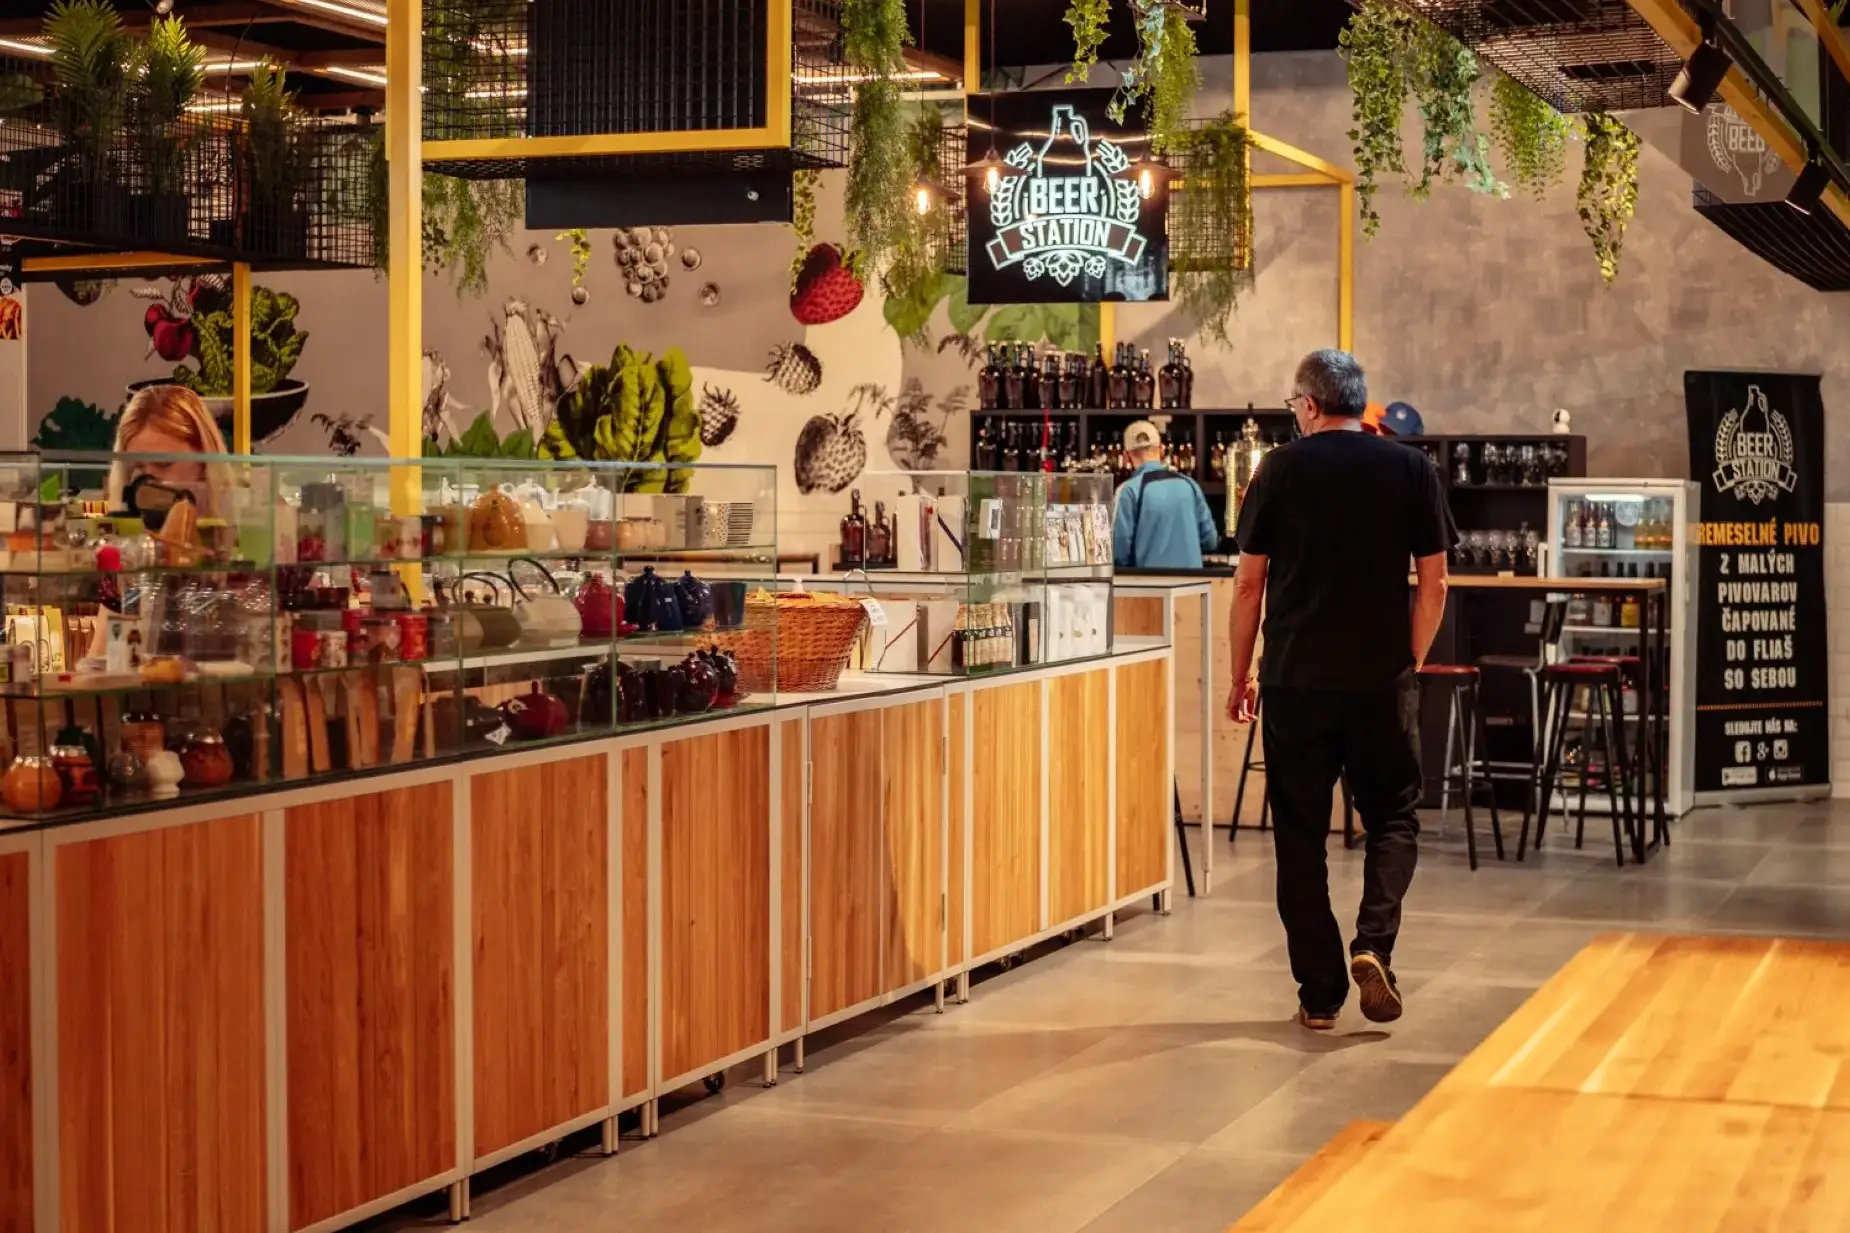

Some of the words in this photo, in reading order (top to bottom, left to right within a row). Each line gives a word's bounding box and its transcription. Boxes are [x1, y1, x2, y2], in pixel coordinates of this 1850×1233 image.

[1030, 177, 1099, 214] BEER
[1019, 219, 1110, 249] STATION
[1737, 432, 1774, 457] BEER
[1732, 458, 1780, 480] STATION
[1696, 516, 1777, 545] REMESELNÉ
[1784, 522, 1820, 545] PIVO
[1719, 552, 1730, 574] Z
[1738, 548, 1795, 574] MALÝCH
[1718, 581, 1797, 603] PIVOVAROV
[1722, 605, 1796, 632] ČAPOVANÉ
[1726, 639, 1746, 661] DO
[1753, 634, 1793, 660] FLIAŠ
[1724, 667, 1744, 690] SO
[1752, 666, 1796, 690] SEBOU
